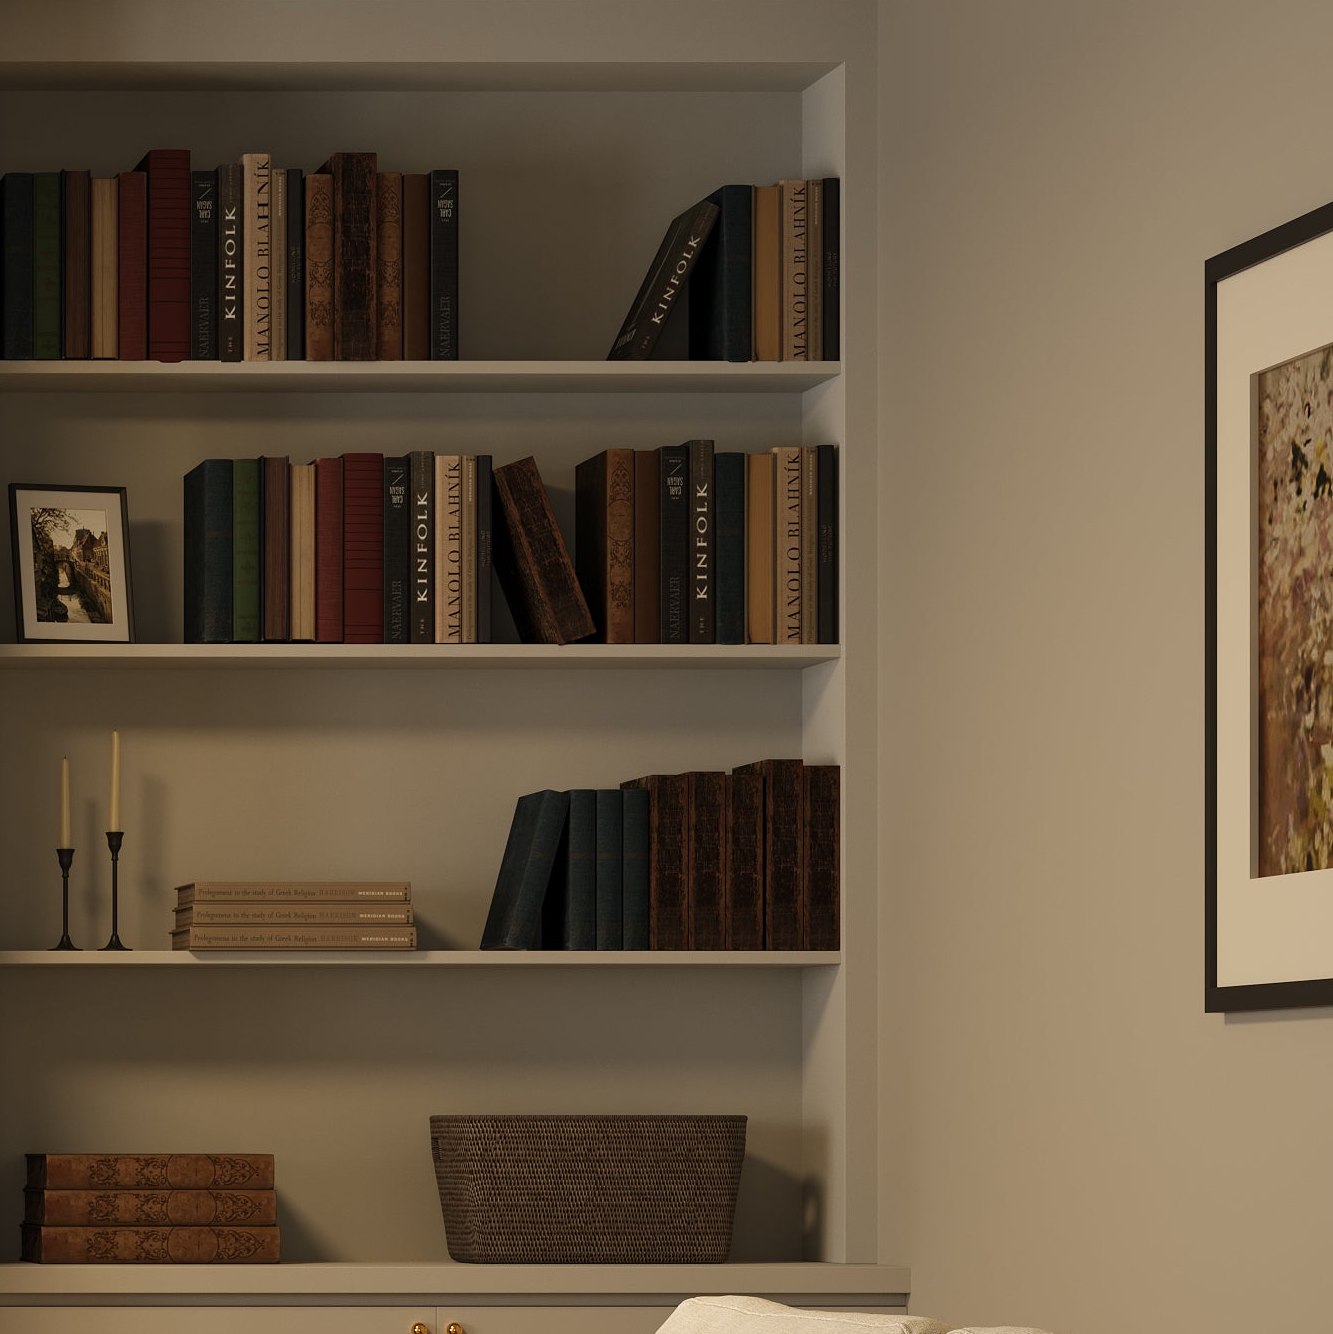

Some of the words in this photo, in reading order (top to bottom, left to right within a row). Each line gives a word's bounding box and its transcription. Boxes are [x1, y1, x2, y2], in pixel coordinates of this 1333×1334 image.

[196, 200, 213, 210] SAGAN
[198, 209, 211, 218] CARL
[253, 161, 270, 257] BLAHNÍK
[437, 199, 454, 209] SAGAN
[790, 186, 806, 264] BLAHNÍK
[224, 206, 237, 320] KINFOLK
[651, 235, 701, 324] KINFOLK
[256, 266, 270, 356] MANOLO
[792, 272, 806, 358] MANOLO
[389, 486, 405, 495] SAGAN
[444, 462, 461, 541] BLAHNÍK
[666, 476, 683, 486] SAGAN
[784, 453, 800, 538] BLAHNÍK
[416, 491, 428, 603] KINFOLK
[695, 482, 708, 599] KINFOLK
[447, 550, 461, 638] MANOLO
[787, 547, 801, 640] MANOLO
[251, 912, 266, 921] study
[294, 912, 317, 921] Religion
[252, 889, 266, 898] study
[294, 889, 316, 898] Religion
[250, 935, 265, 944] study
[294, 935, 317, 944] Religion
